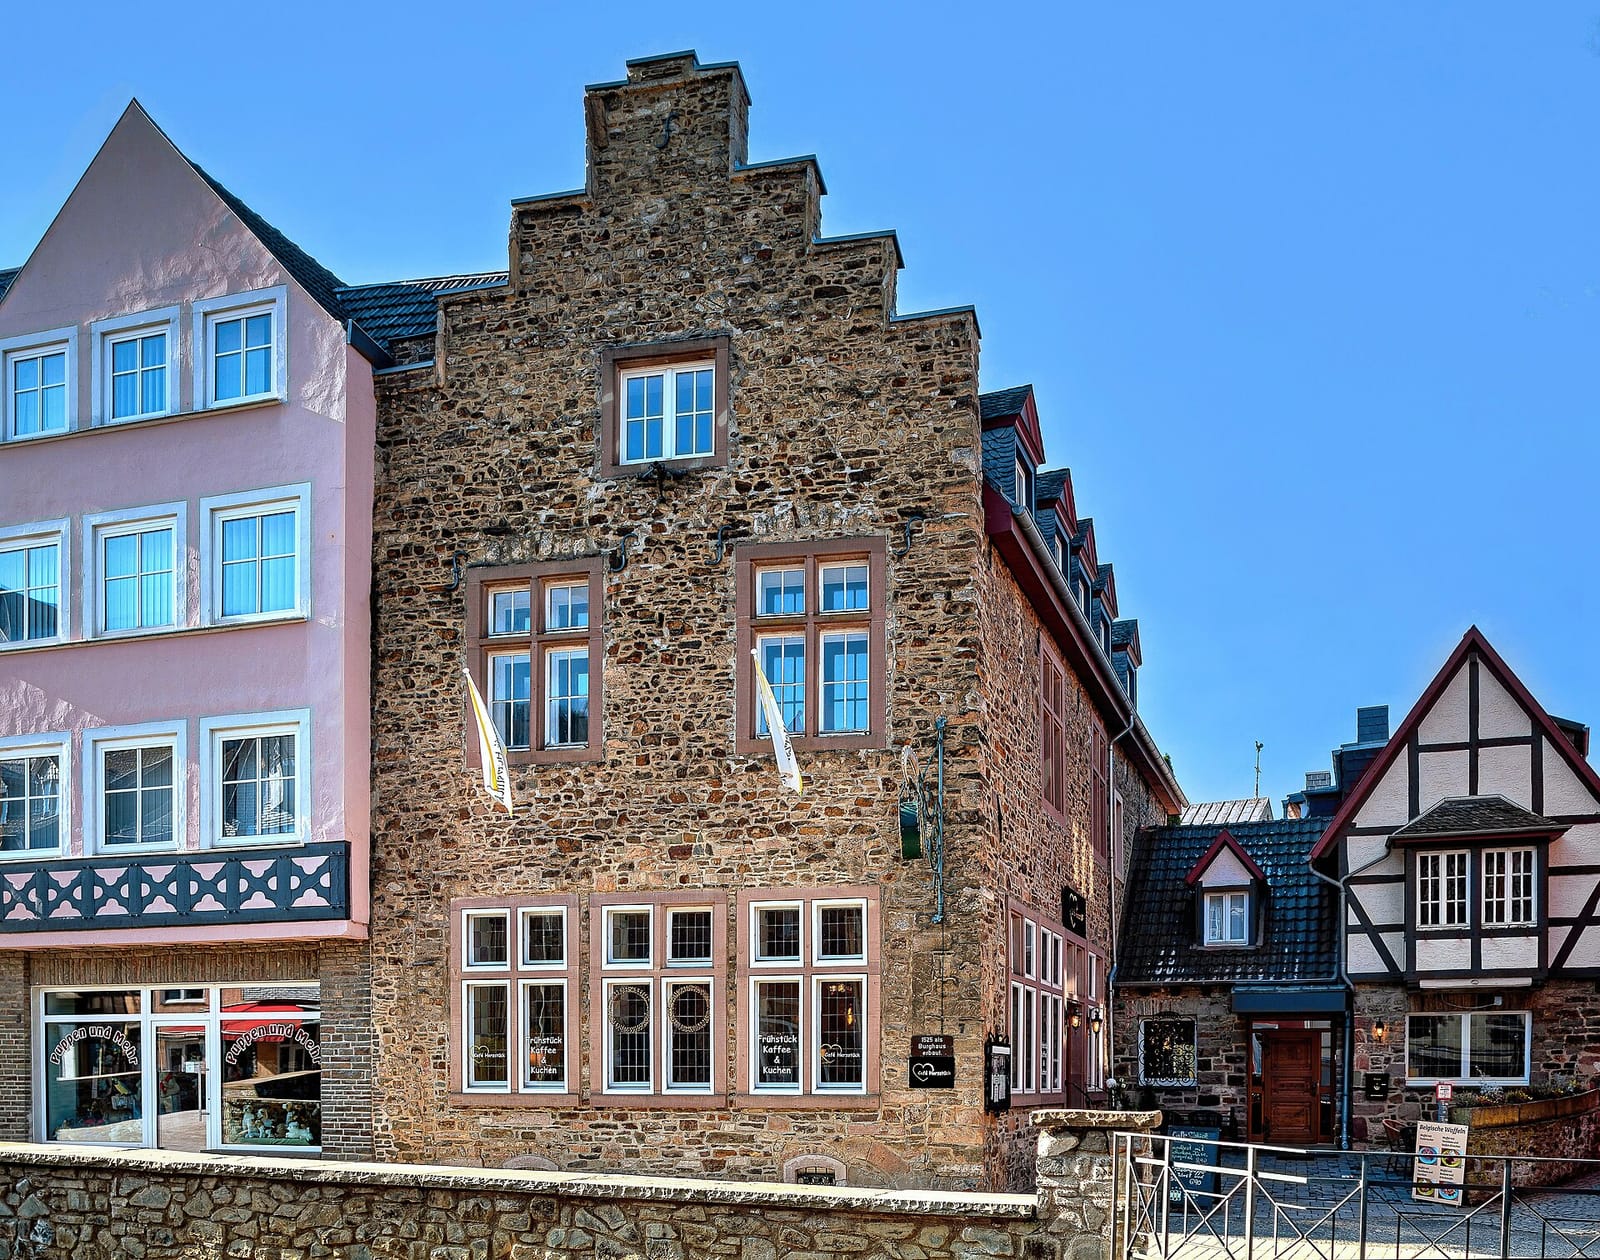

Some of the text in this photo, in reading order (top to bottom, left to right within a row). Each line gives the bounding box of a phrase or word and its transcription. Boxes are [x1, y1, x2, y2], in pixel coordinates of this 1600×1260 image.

[758, 1034, 798, 1043] Frühstück
[50, 1026, 138, 1065] Puppen und Mehr
[226, 1023, 321, 1065] Puppen und Mehr
[530, 1046, 557, 1054] Kaffee
[762, 1045, 792, 1054] Kaffee
[541, 1056, 547, 1064] &
[773, 1056, 780, 1064] &
[530, 1066, 557, 1074] Kuchen
[762, 1066, 792, 1075] Kuchen
[1420, 1124, 1466, 1135] Belgische Waffeln
